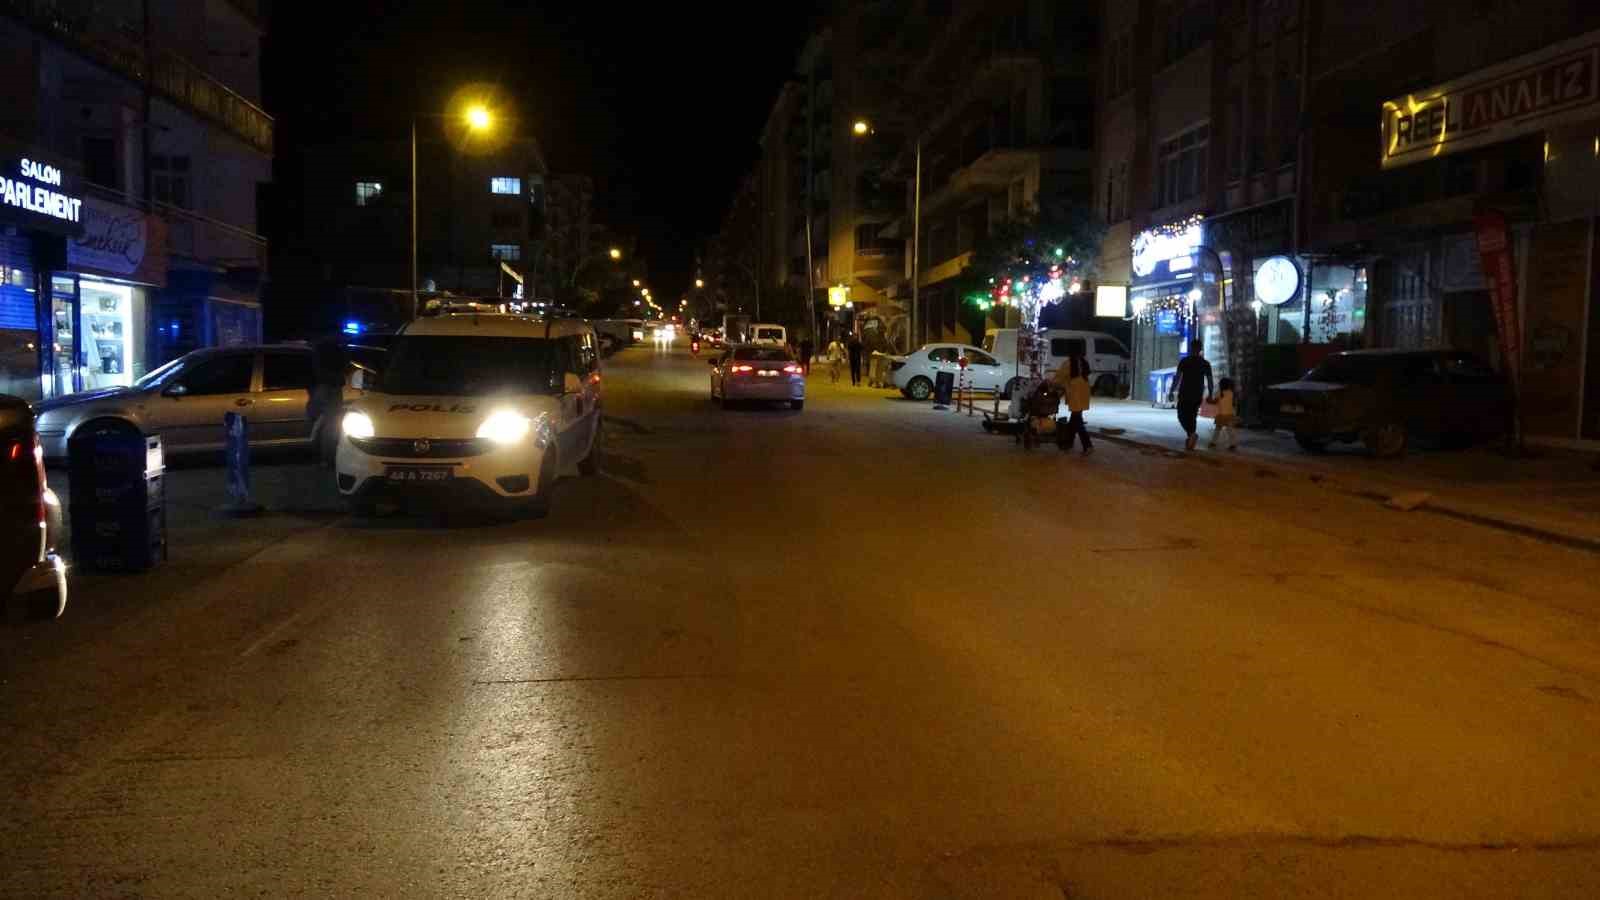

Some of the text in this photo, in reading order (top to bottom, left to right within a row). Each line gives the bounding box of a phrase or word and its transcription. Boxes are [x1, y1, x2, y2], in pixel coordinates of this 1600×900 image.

[1397, 98, 1458, 147] REEL
[21, 158, 61, 186] SALON
[0, 176, 82, 222] PARLEMENT
